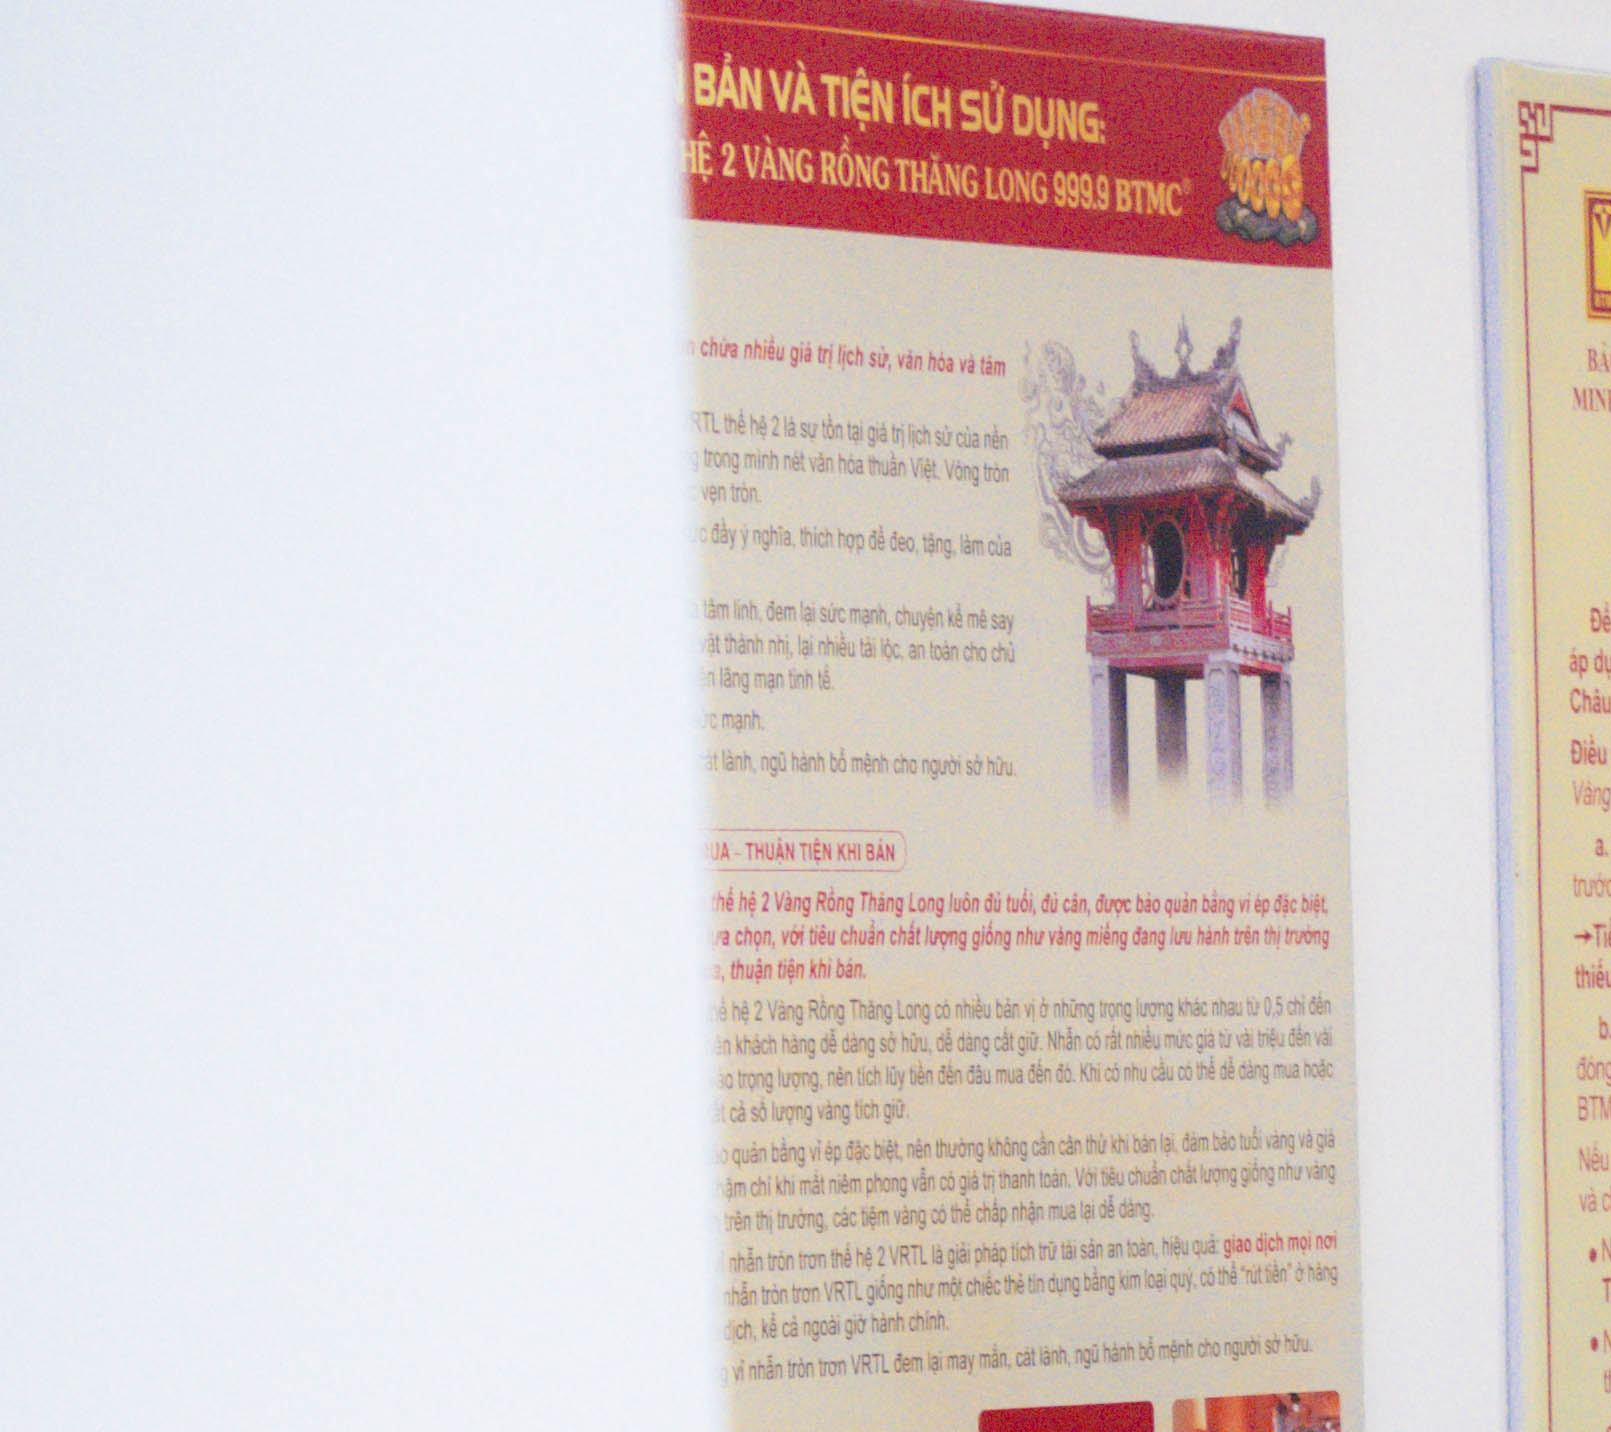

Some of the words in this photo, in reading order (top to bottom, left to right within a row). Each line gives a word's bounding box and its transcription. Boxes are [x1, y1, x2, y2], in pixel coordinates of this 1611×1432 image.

[694, 53, 763, 111] BẢN
[769, 60, 812, 114] VÀ
[821, 68, 894, 131] TIỆN
[902, 73, 952, 129] ÍCH
[961, 79, 1003, 134] SỬ
[1013, 95, 1106, 150] DỤNG:
[722, 139, 735, 177] 2
[743, 142, 813, 182] VÀNG
[821, 133, 889, 189] RỒNG
[898, 153, 978, 198] THĂNG
[984, 167, 1048, 204] LONG
[1055, 175, 1109, 210] 999.9
[1116, 178, 1182, 216] BTMC
[1571, 734, 1607, 769] Điều
